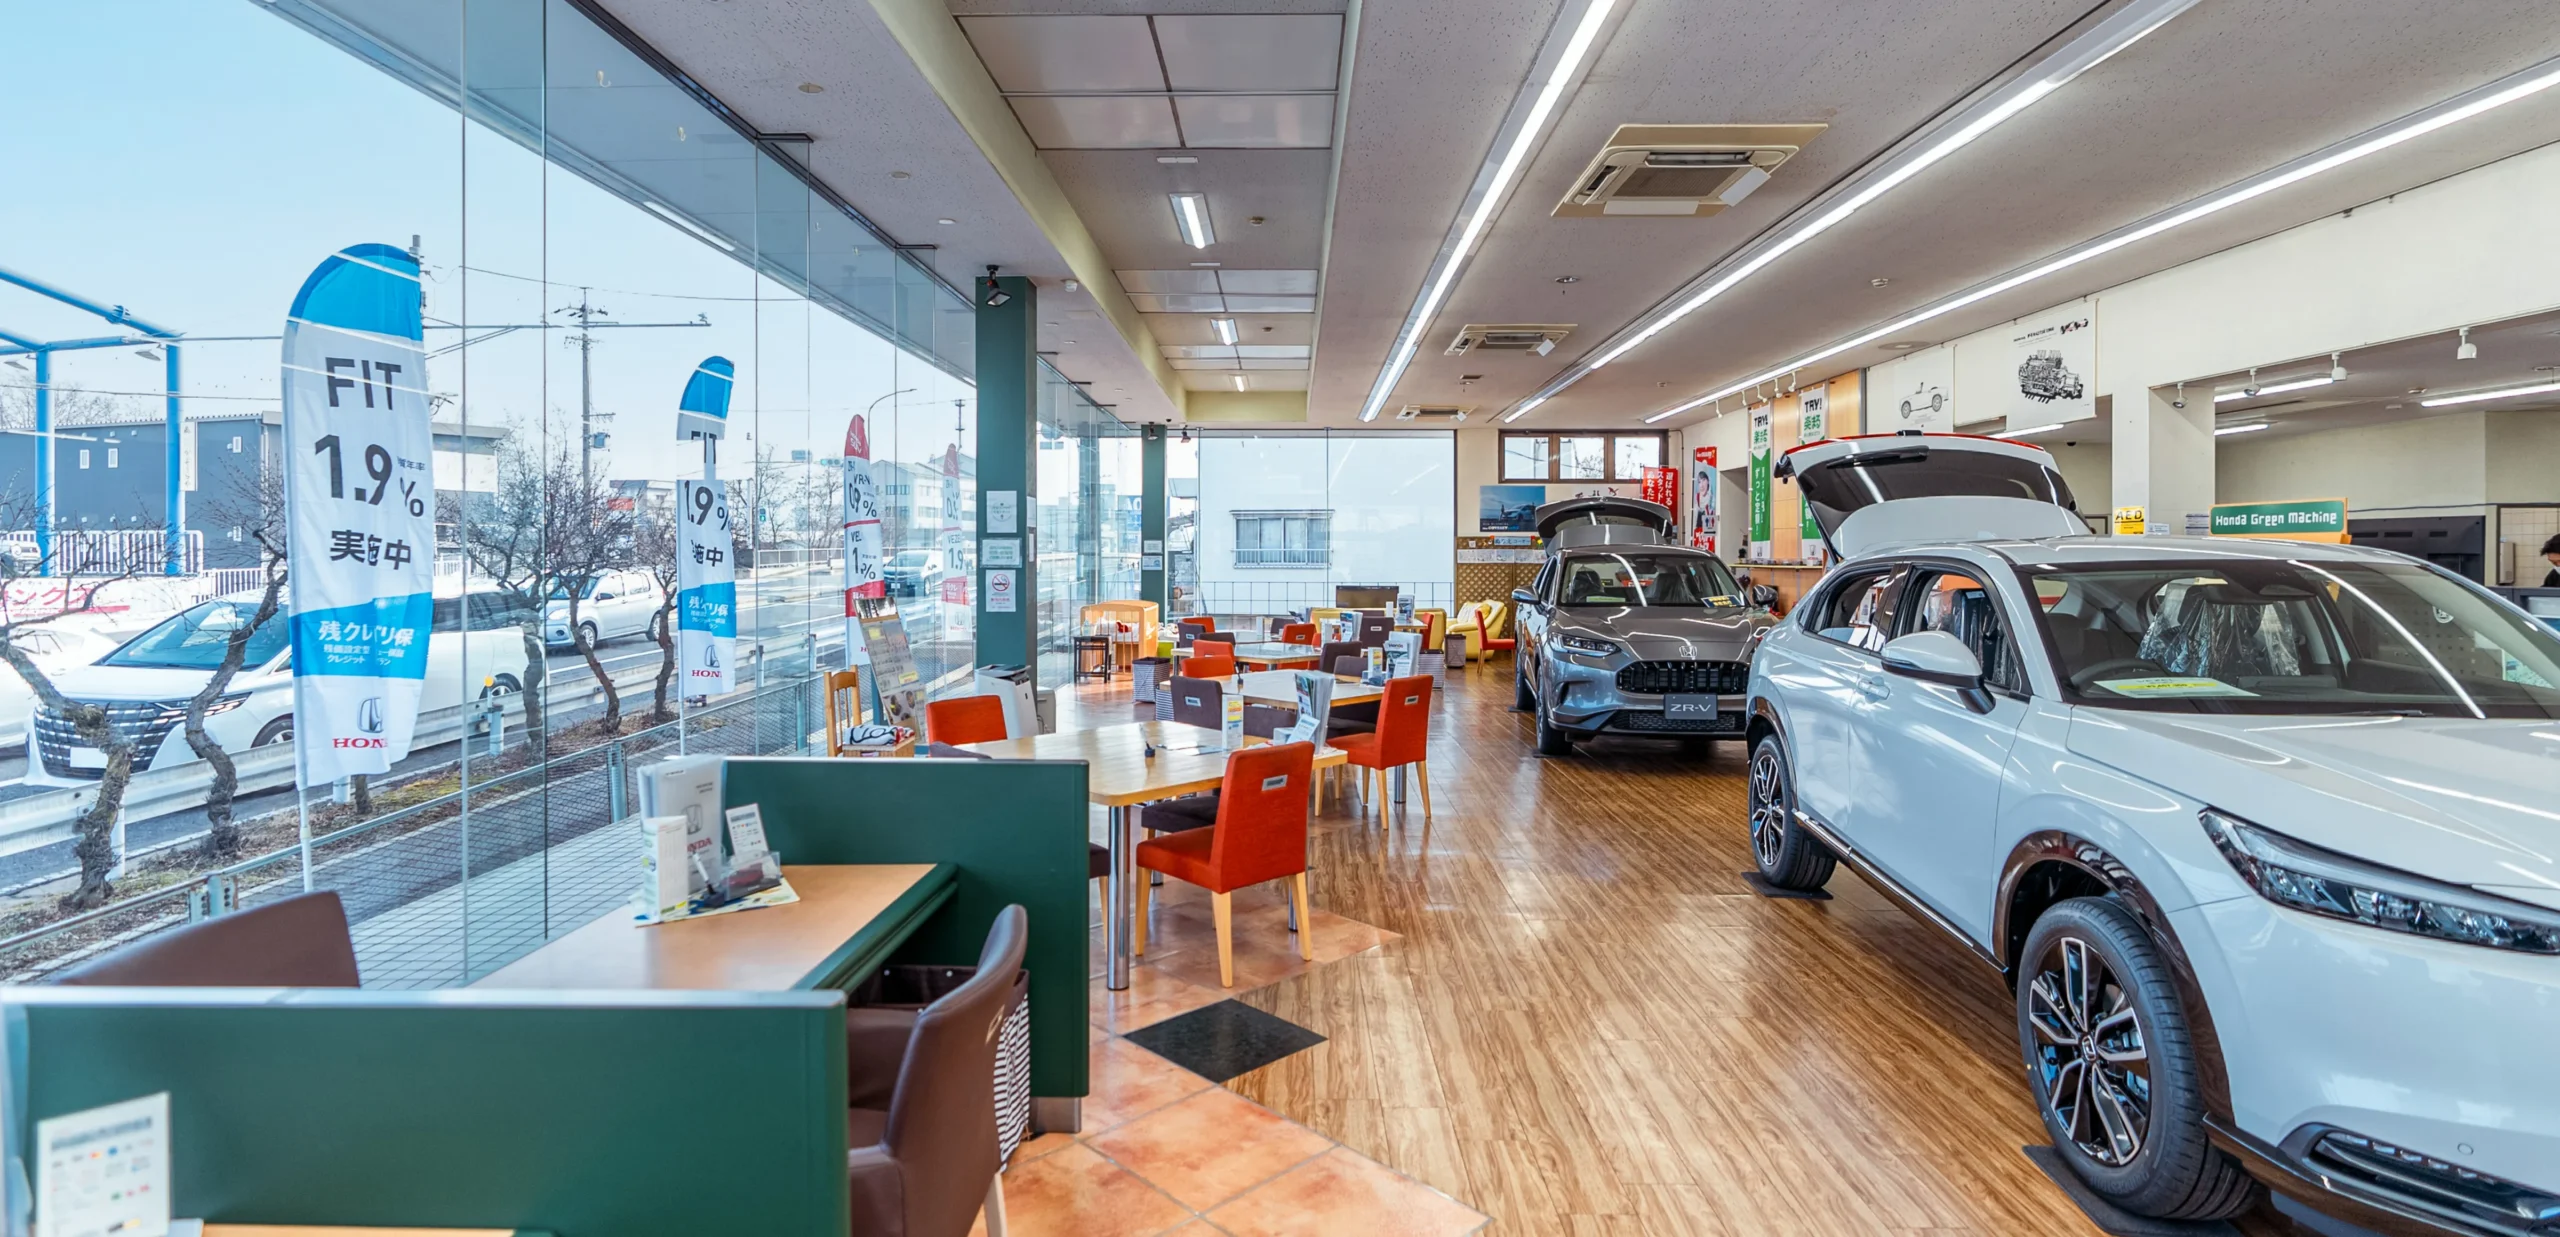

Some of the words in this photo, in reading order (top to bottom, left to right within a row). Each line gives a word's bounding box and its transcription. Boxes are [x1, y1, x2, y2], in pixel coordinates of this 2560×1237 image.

[326, 357, 402, 411] FIT
[1805, 398, 1822, 413] TRY!
[1754, 414, 1769, 428] TRY!
[2115, 509, 2142, 520] AED
[2216, 514, 2247, 526] Honda
[2251, 513, 2284, 527] Green
[692, 669, 723, 678] HON
[1670, 703, 1711, 712] ZR-V
[332, 737, 389, 749] HON
